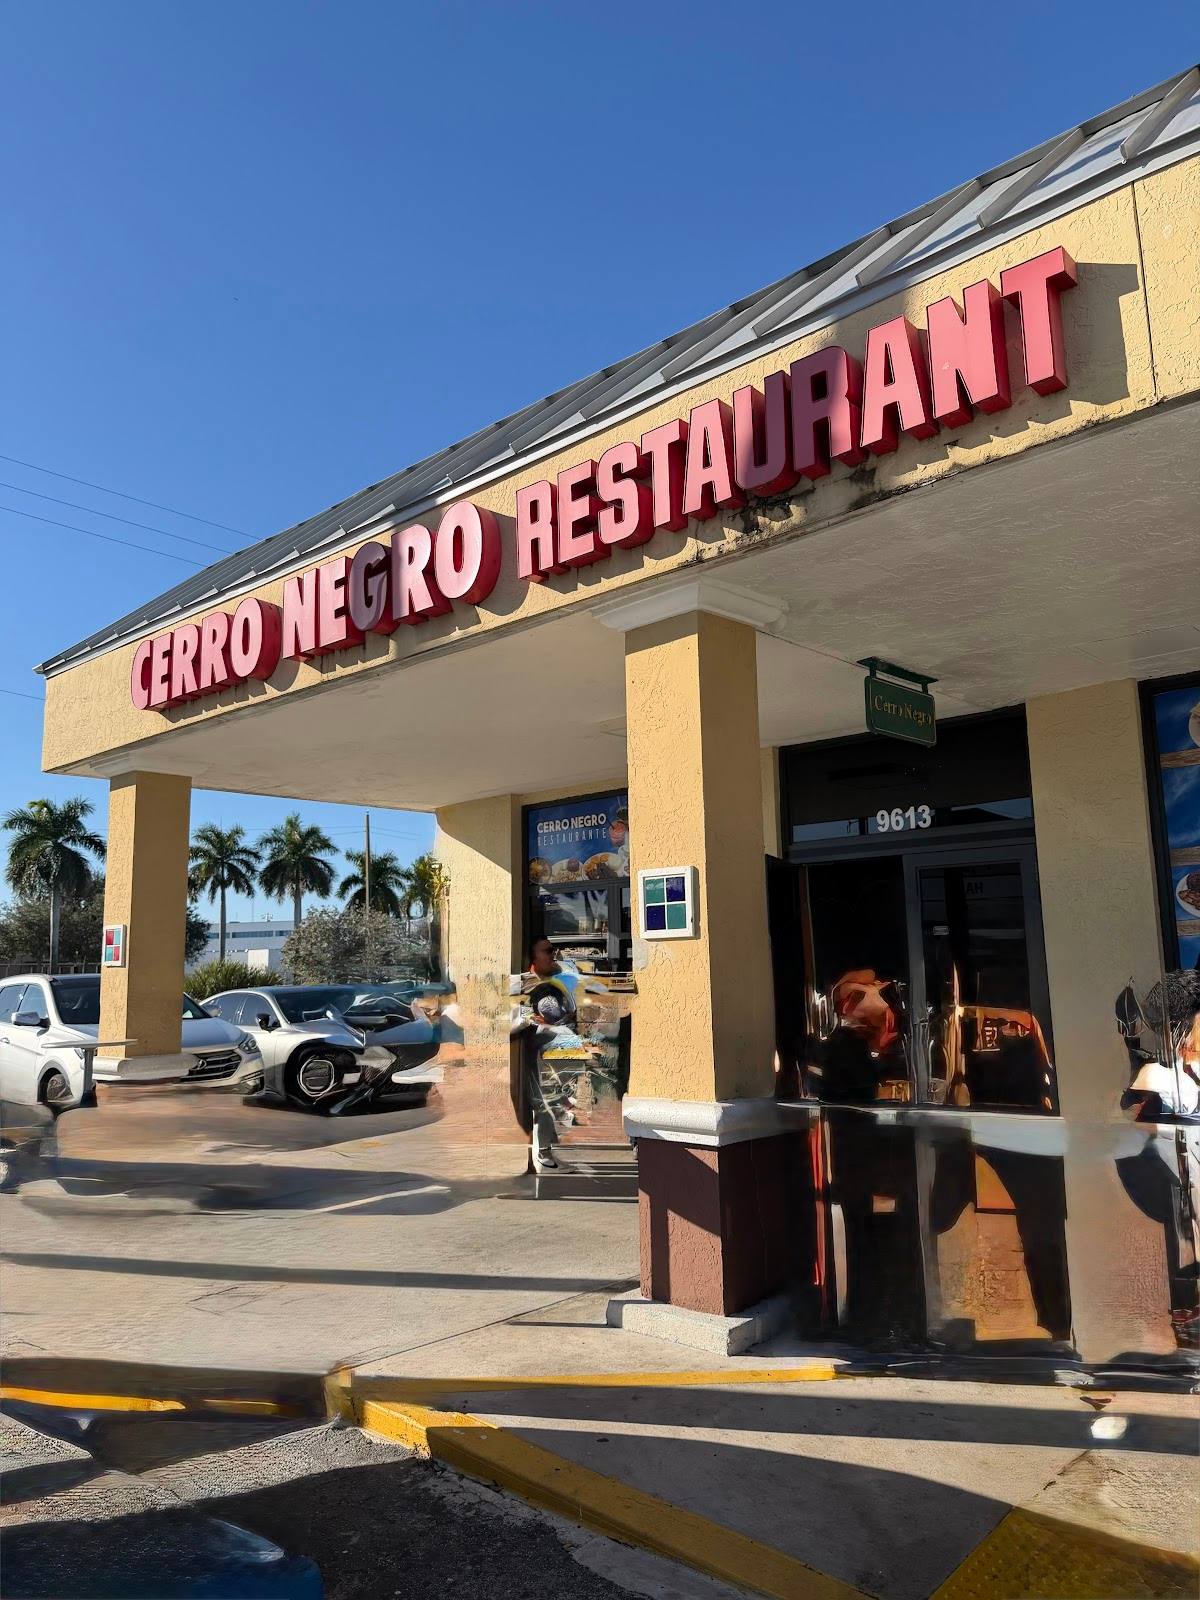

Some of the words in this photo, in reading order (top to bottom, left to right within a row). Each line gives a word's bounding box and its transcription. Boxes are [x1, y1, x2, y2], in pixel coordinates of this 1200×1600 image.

[131, 597, 280, 711] CERRO
[282, 501, 500, 662] NEGRO
[515, 245, 1078, 583] RESTAURANT
[537, 818, 569, 834] CERRO
[570, 813, 607, 829] NEGRO
[876, 804, 931, 832] 9613
